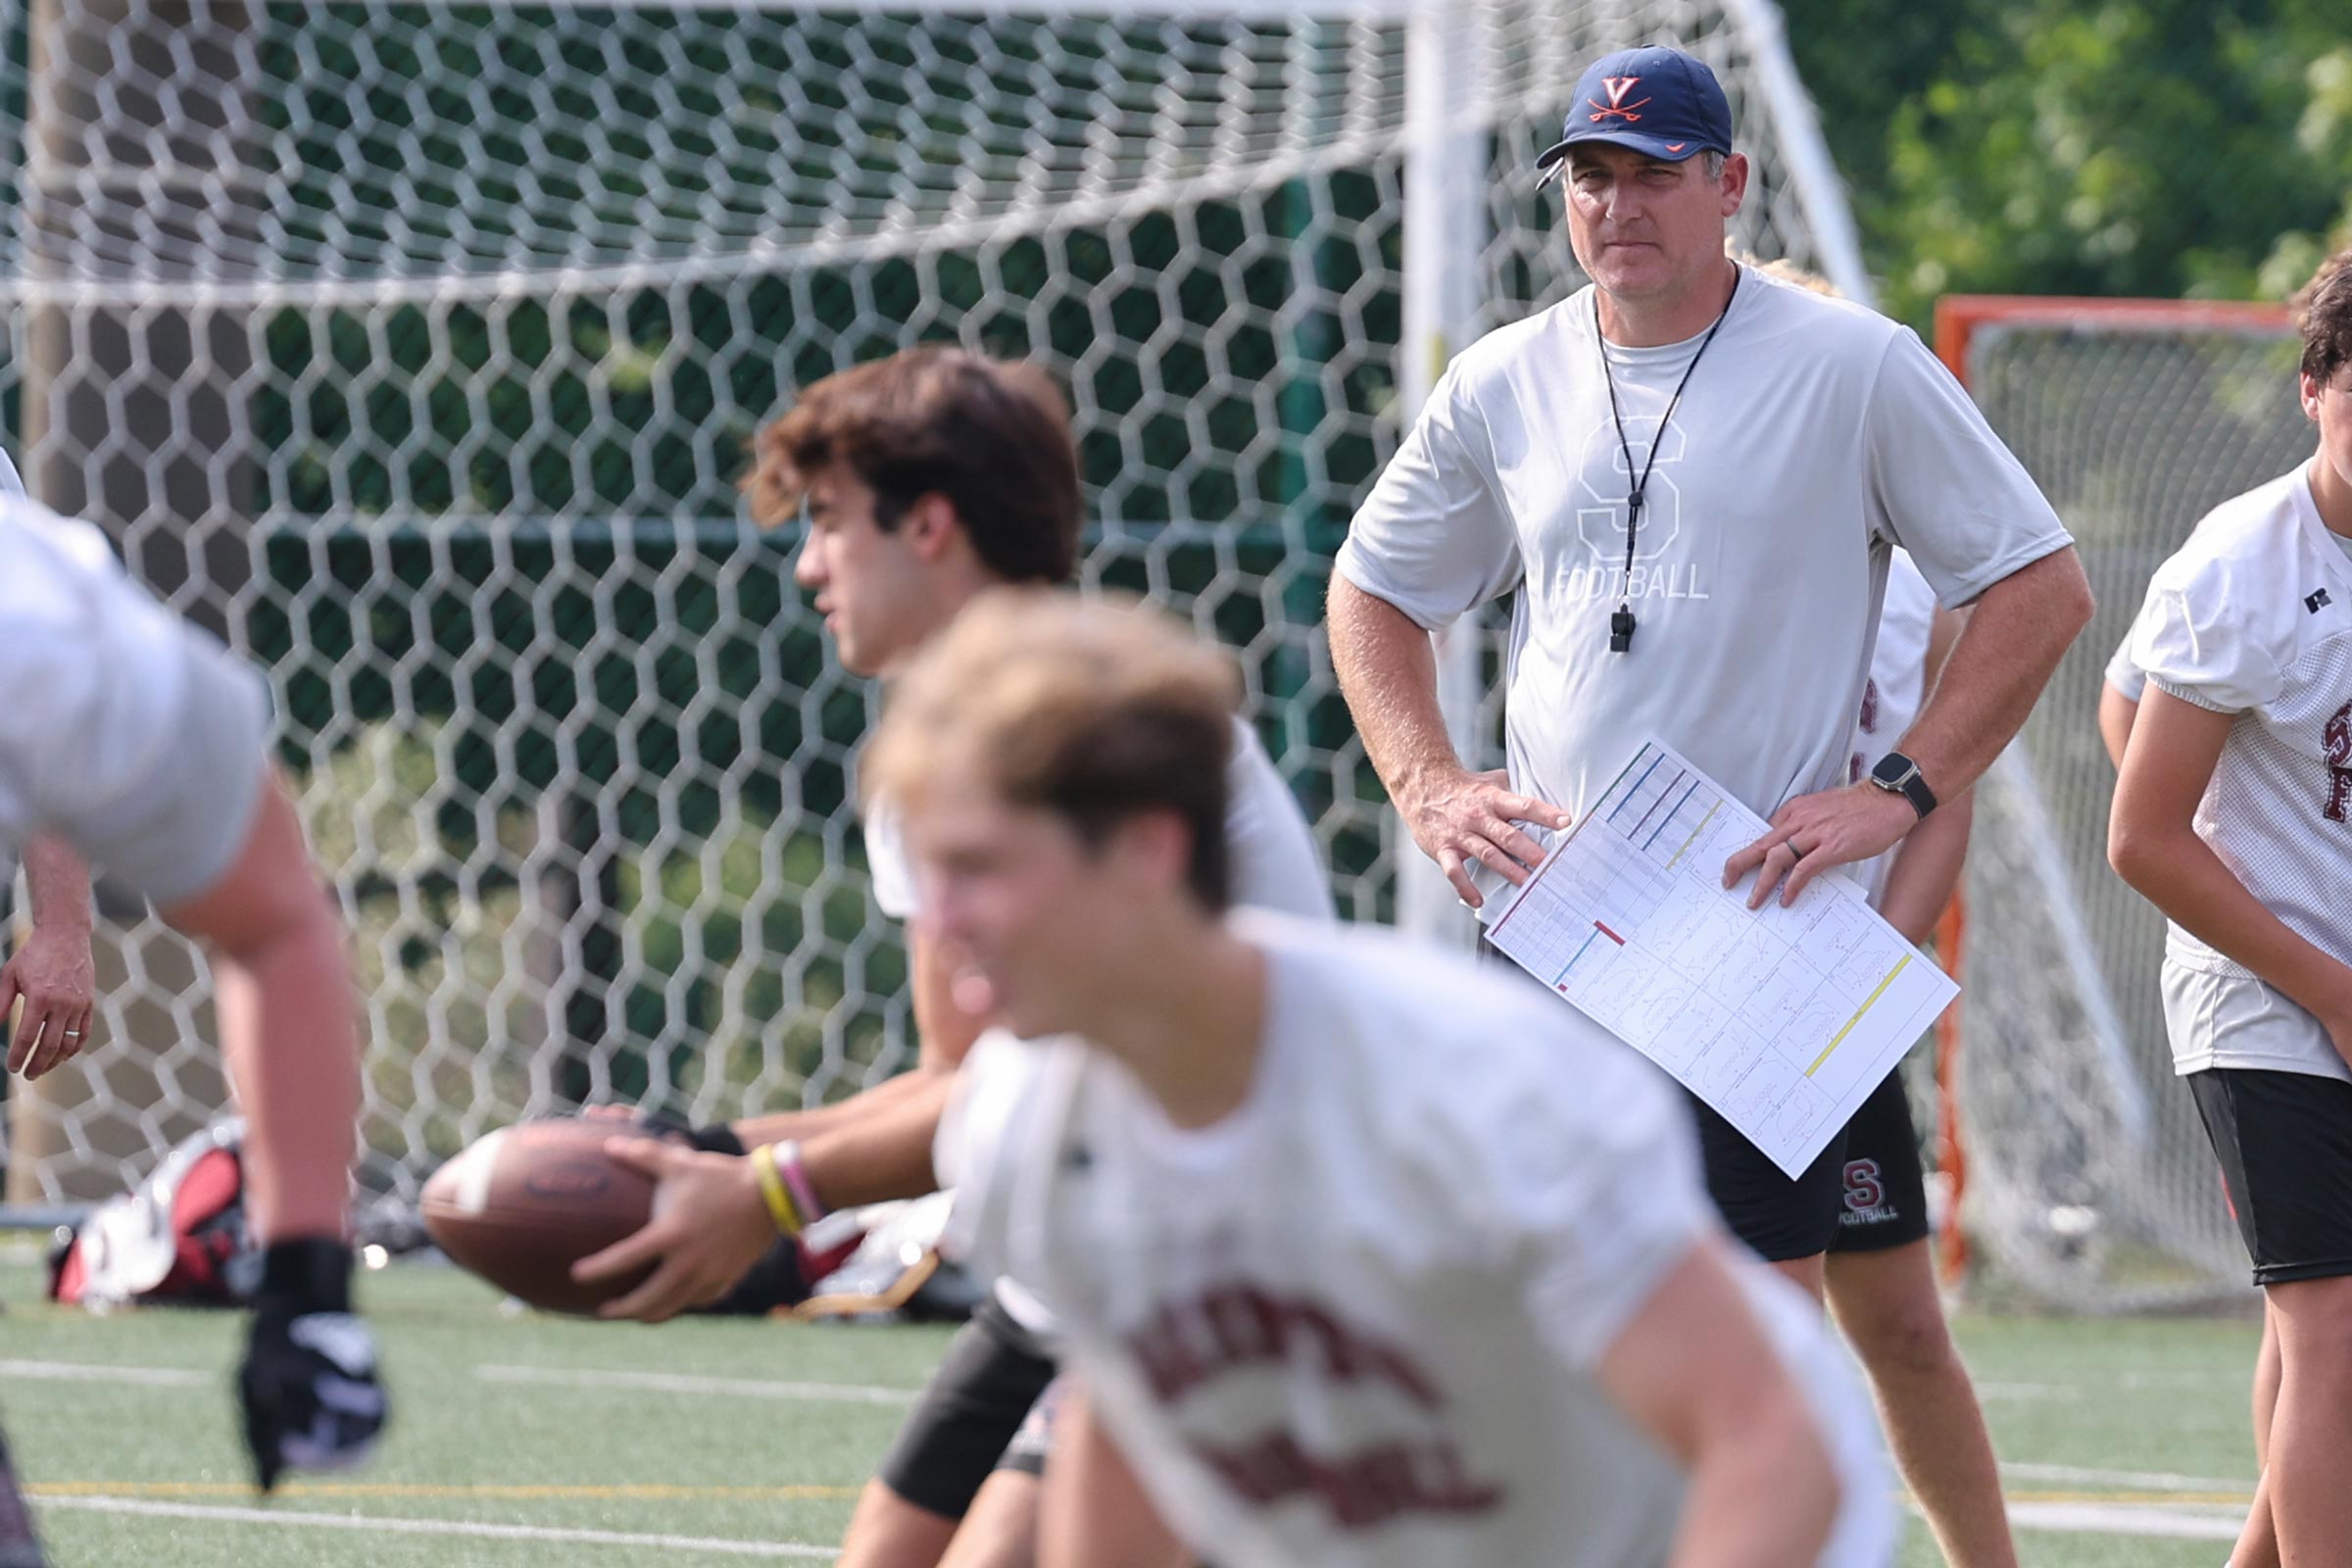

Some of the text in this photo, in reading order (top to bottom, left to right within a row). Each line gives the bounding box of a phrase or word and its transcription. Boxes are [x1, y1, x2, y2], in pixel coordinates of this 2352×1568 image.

[1601, 76, 1641, 109] V
[1577, 416, 1687, 561] S
[1550, 564, 1709, 600] FOOTBALL
[1843, 1158, 1884, 1210] S
